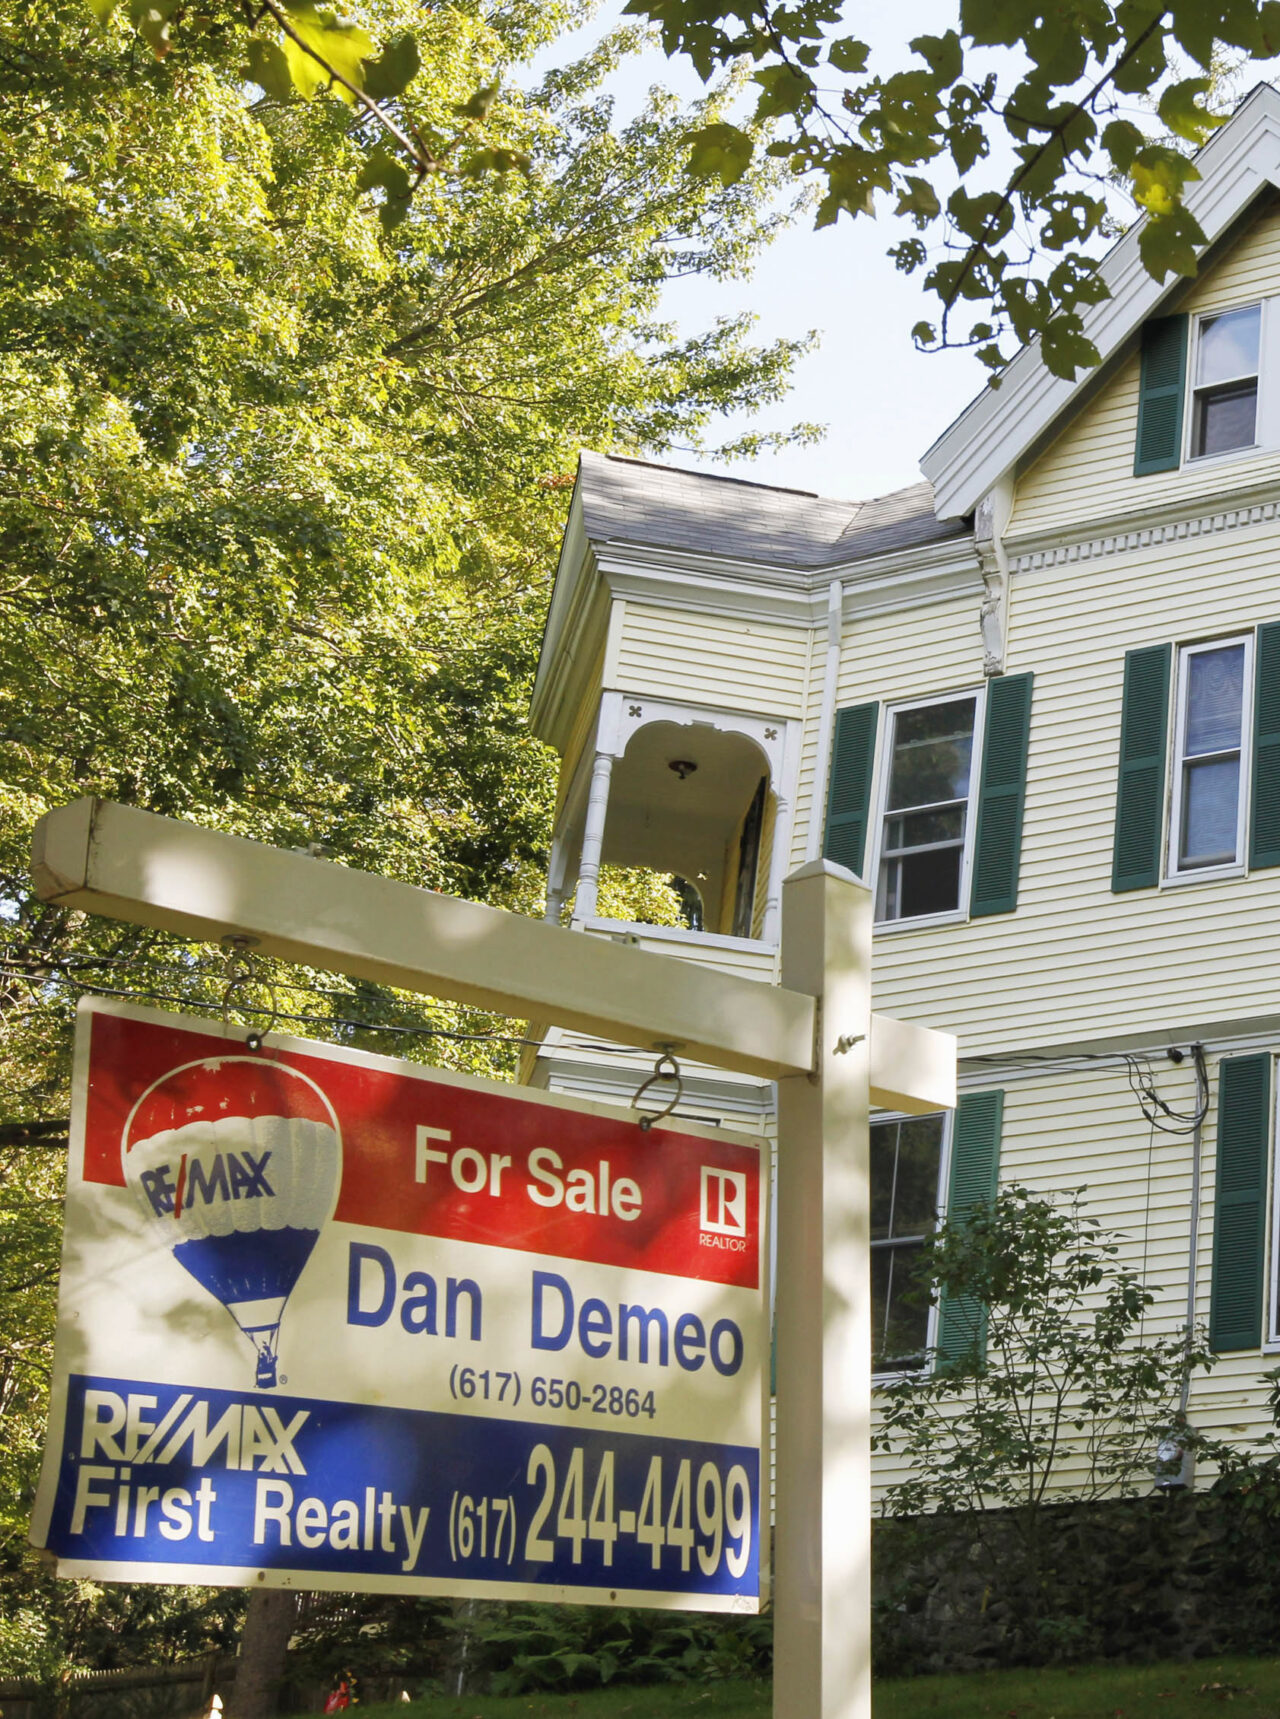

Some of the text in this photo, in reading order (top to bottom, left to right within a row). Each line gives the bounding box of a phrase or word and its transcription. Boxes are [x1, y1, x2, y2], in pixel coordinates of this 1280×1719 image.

[140, 1150, 276, 1219] RE/MAX
[414, 1124, 643, 1222] For Sale
[699, 1232, 746, 1253] REALTOR
[346, 1241, 744, 1377] Dan Demeo
[80, 1389, 311, 1476] RE/MAX
[449, 1364, 657, 1419] (617) 650-2864
[69, 1443, 752, 1579] First Realty (617) 244-4499
